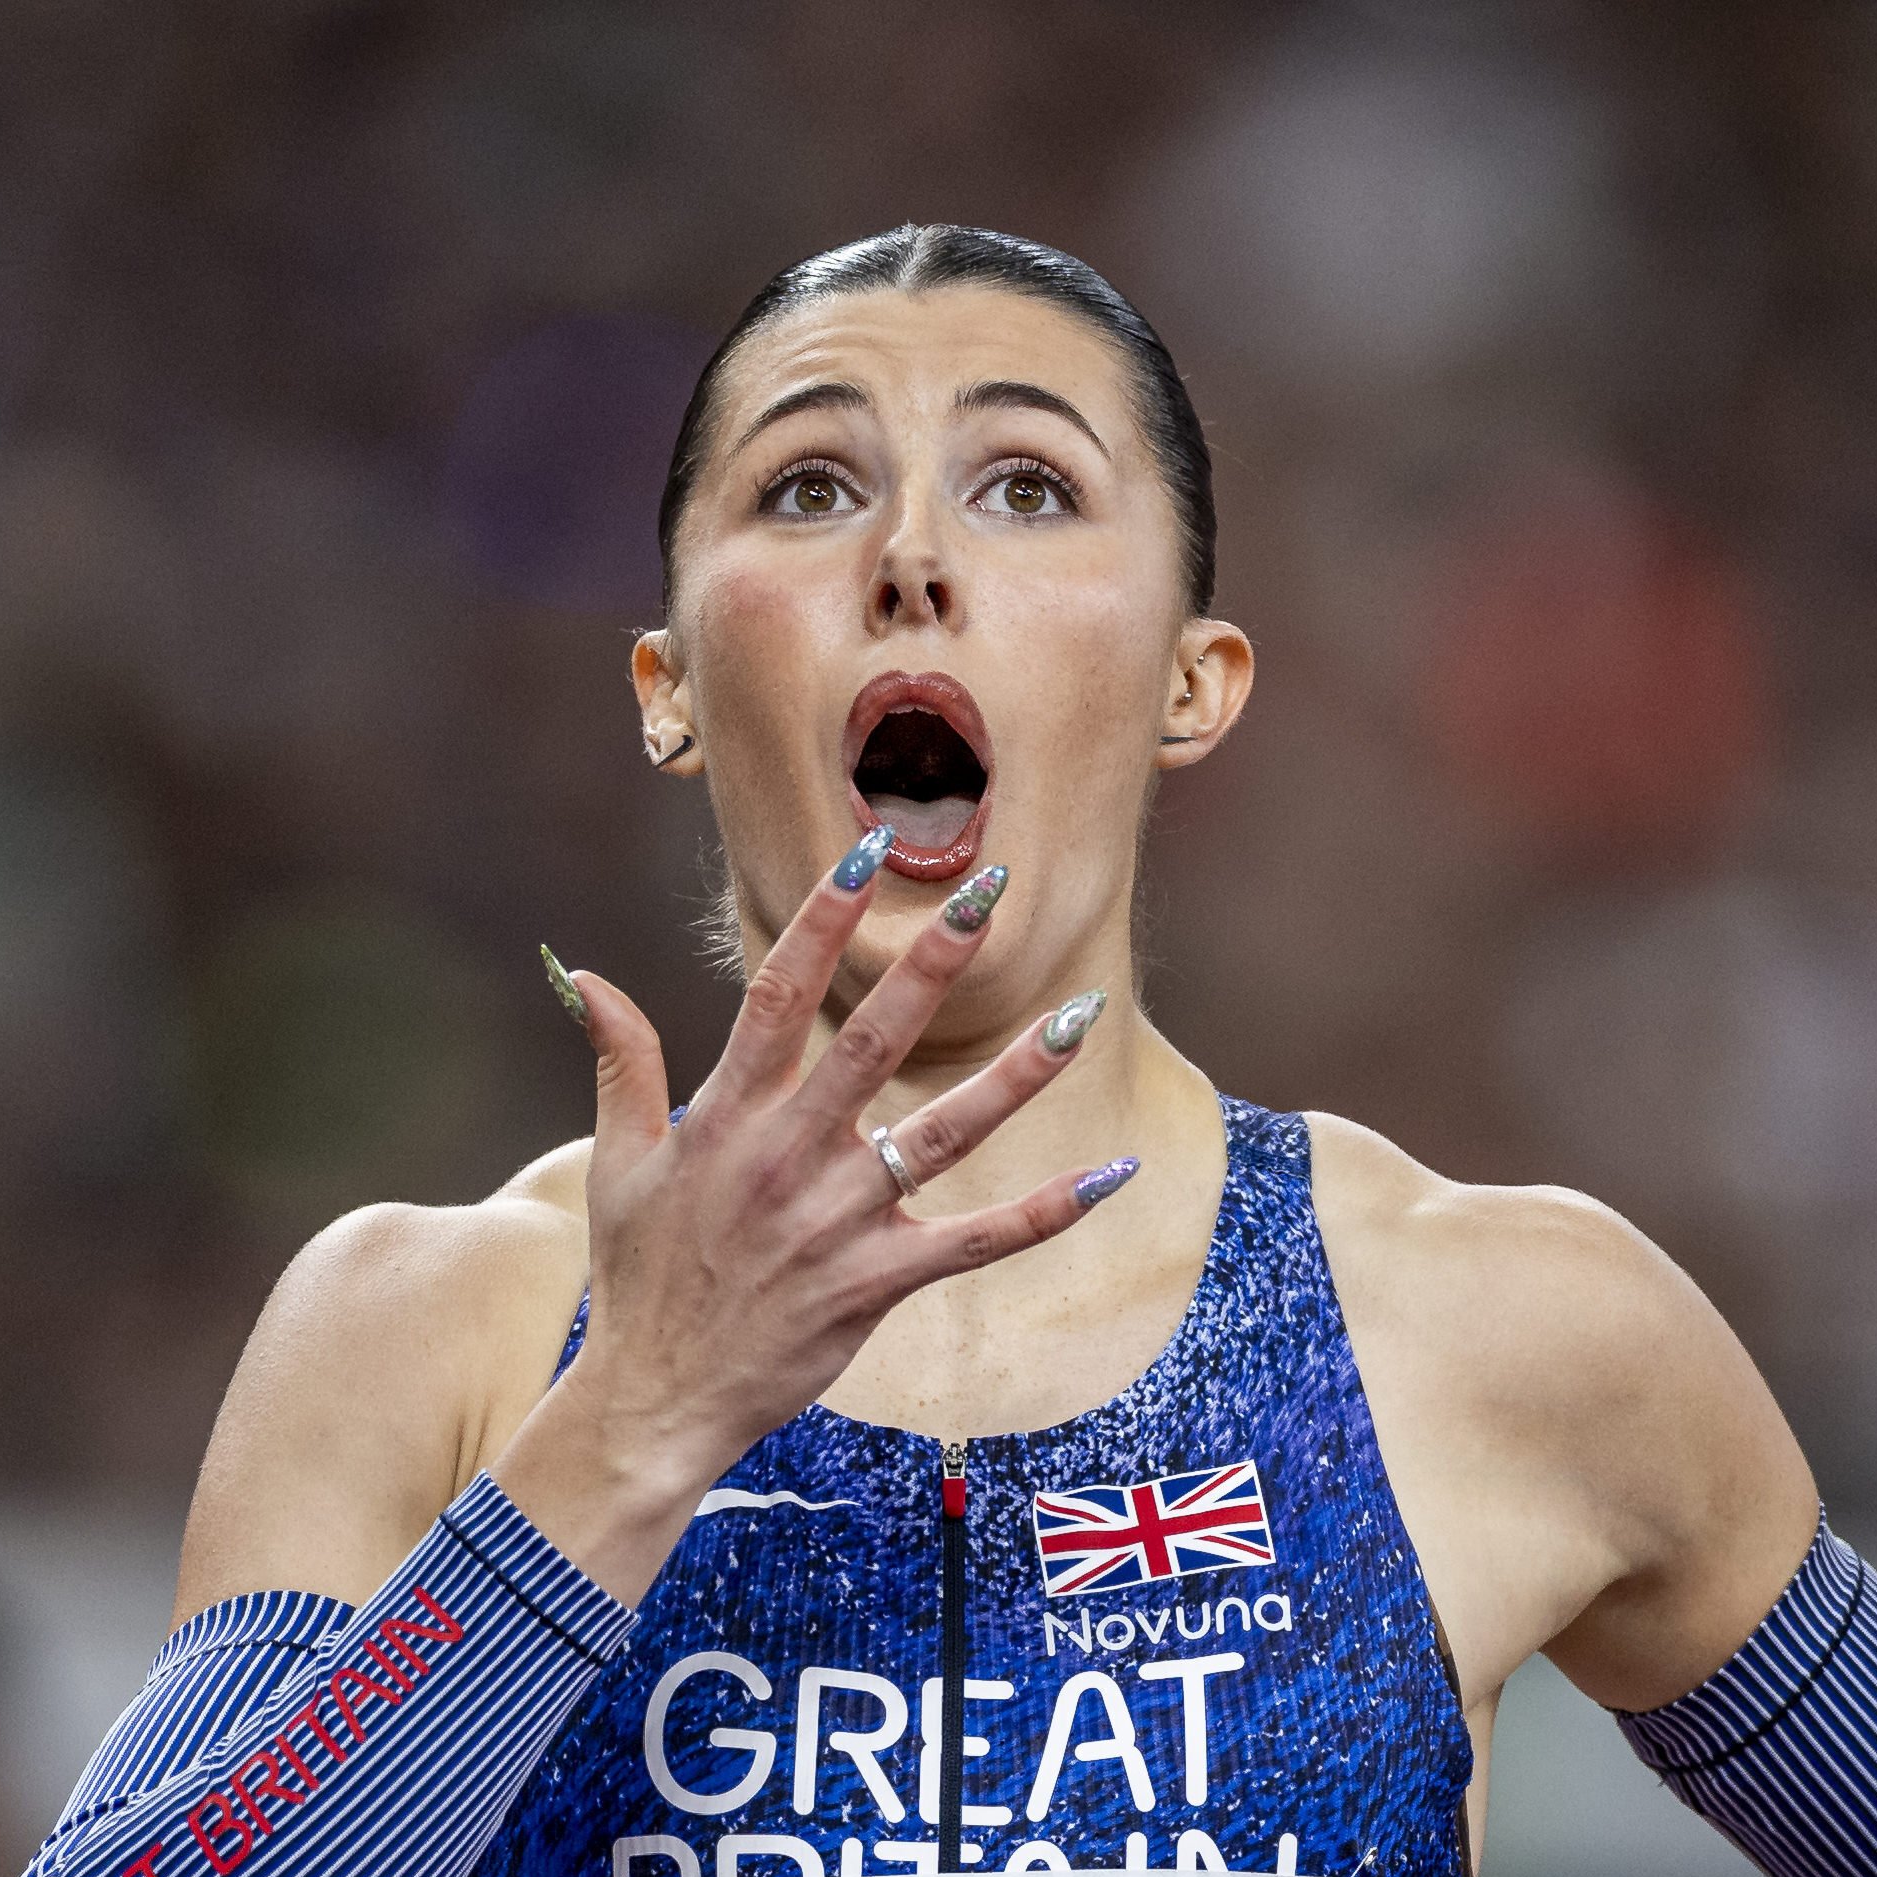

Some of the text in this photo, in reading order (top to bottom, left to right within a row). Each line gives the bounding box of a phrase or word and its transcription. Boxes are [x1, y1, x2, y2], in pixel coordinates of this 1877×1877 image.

[1043, 1593, 1292, 1656] Novuna
[187, 1586, 463, 1876] BRITAIN
[643, 1650, 1245, 1827] GREAT
